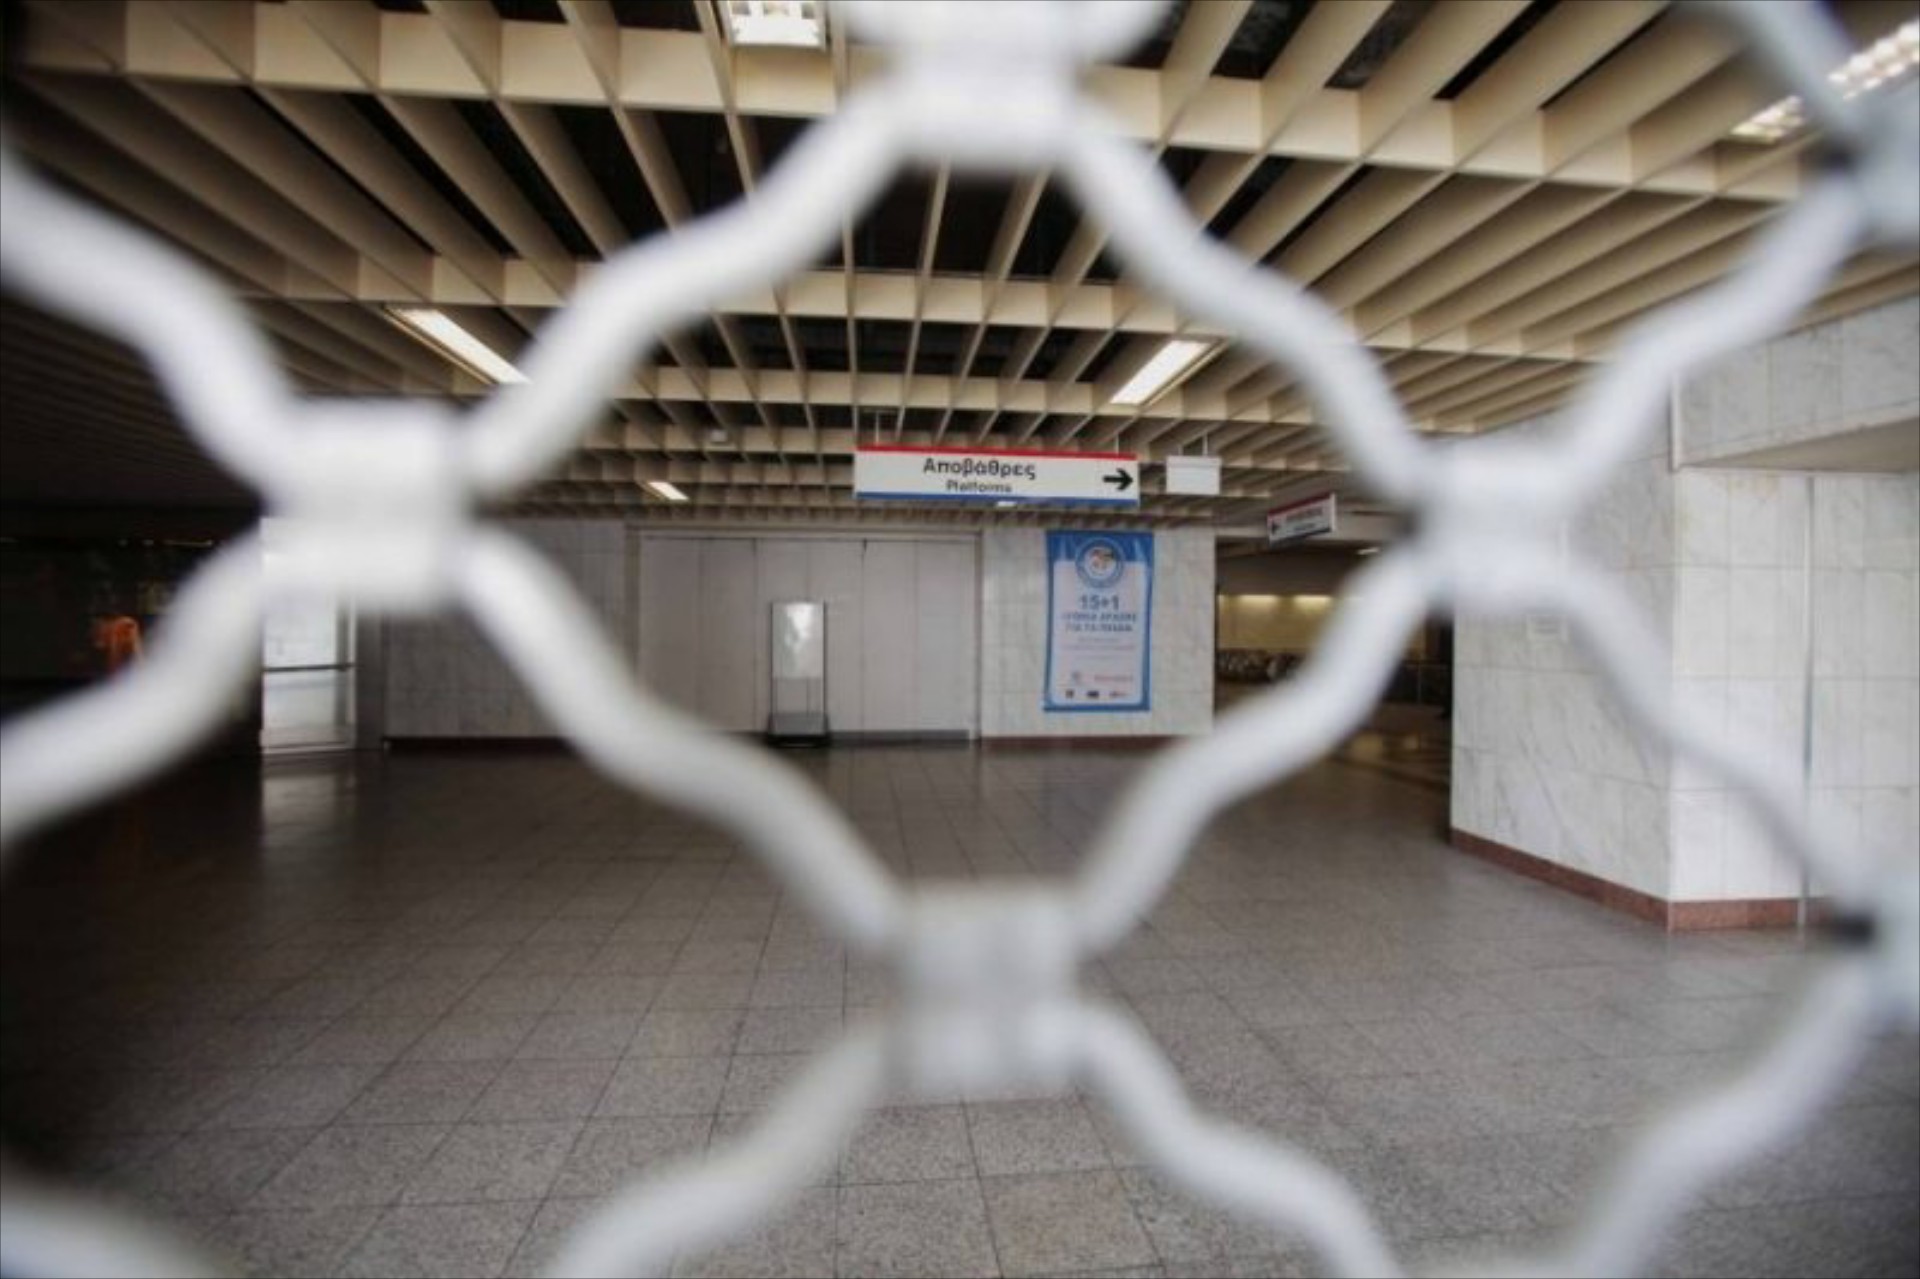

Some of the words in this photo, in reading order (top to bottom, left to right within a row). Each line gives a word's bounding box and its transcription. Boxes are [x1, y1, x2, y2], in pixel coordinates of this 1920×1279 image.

[923, 457, 1036, 480] Αποβάθρες
[946, 479, 1012, 492] Platforms
[1079, 594, 1120, 611] 15+1
